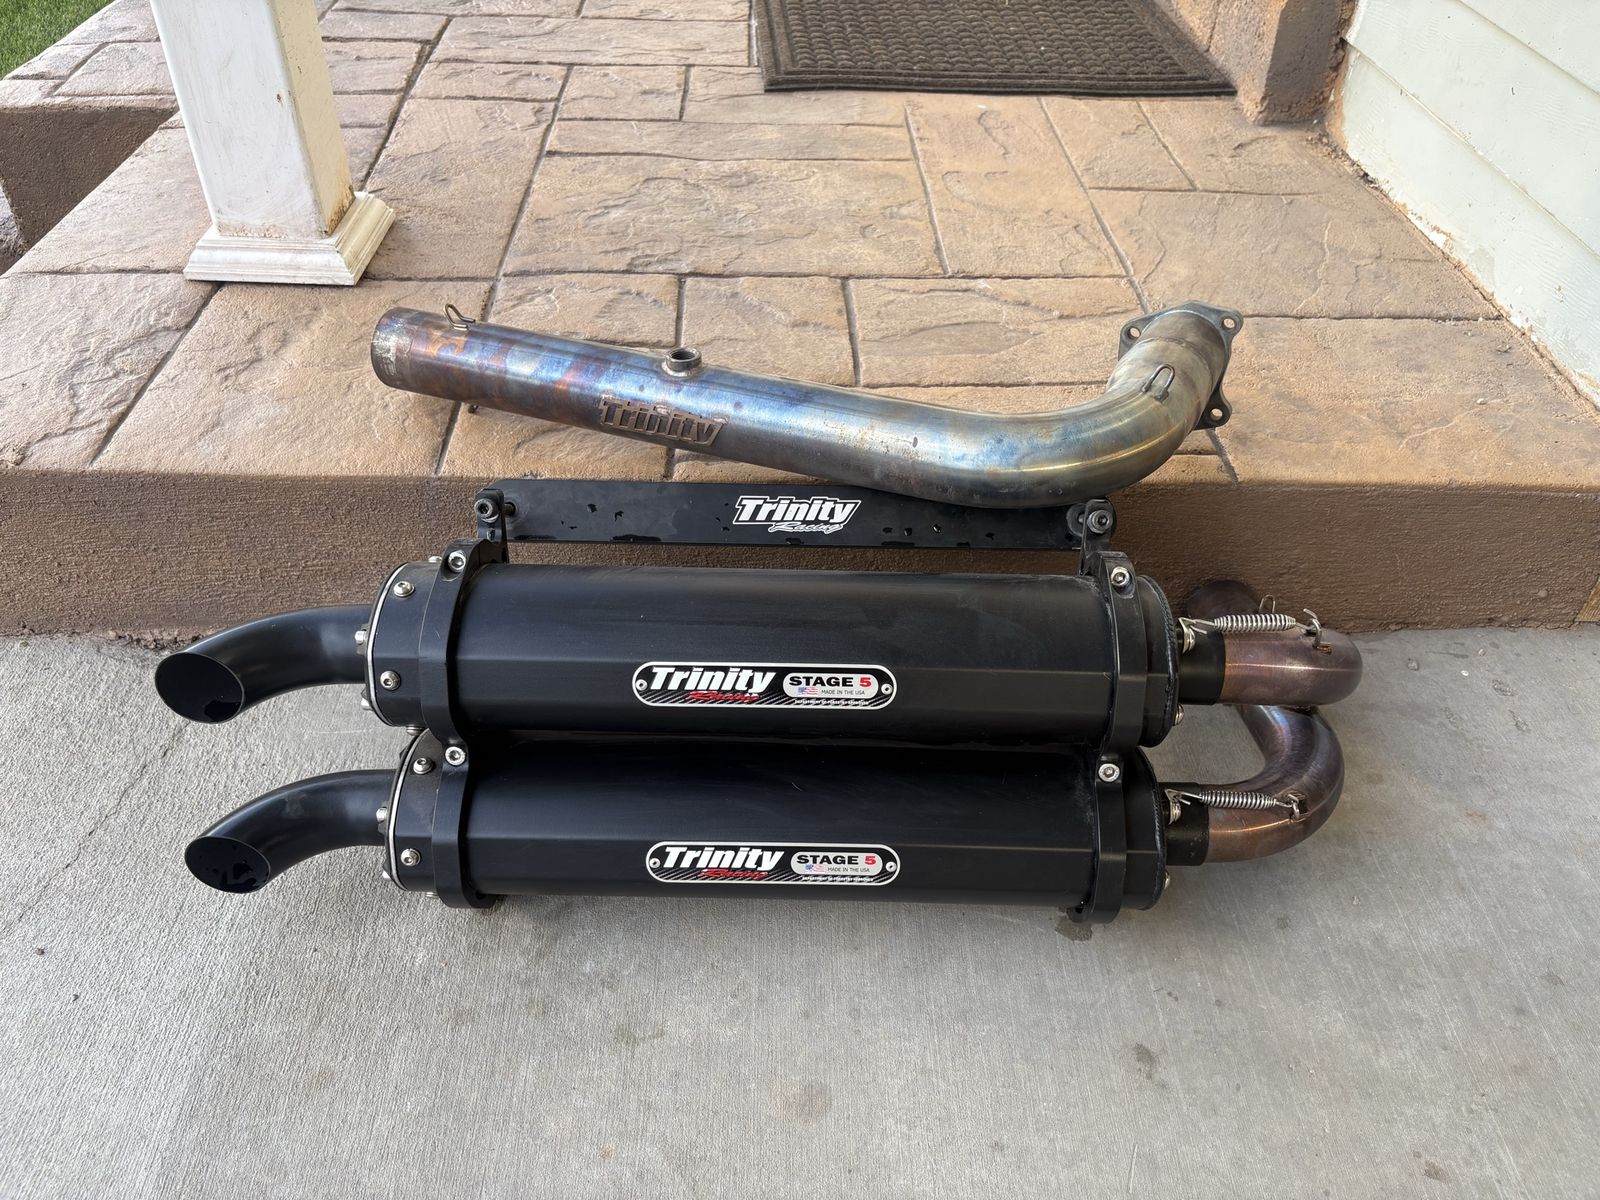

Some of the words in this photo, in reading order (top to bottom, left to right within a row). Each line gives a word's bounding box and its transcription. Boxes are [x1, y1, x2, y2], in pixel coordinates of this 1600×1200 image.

[601, 398, 724, 445] Trinity
[735, 496, 860, 524] Trinity
[768, 521, 843, 534] Racing
[650, 667, 776, 693] Trinity
[789, 676, 853, 687] STAGE
[859, 677, 872, 688] 5
[663, 846, 785, 871] Trinity
[796, 855, 859, 865] STAGE
[864, 855, 877, 865] 5
